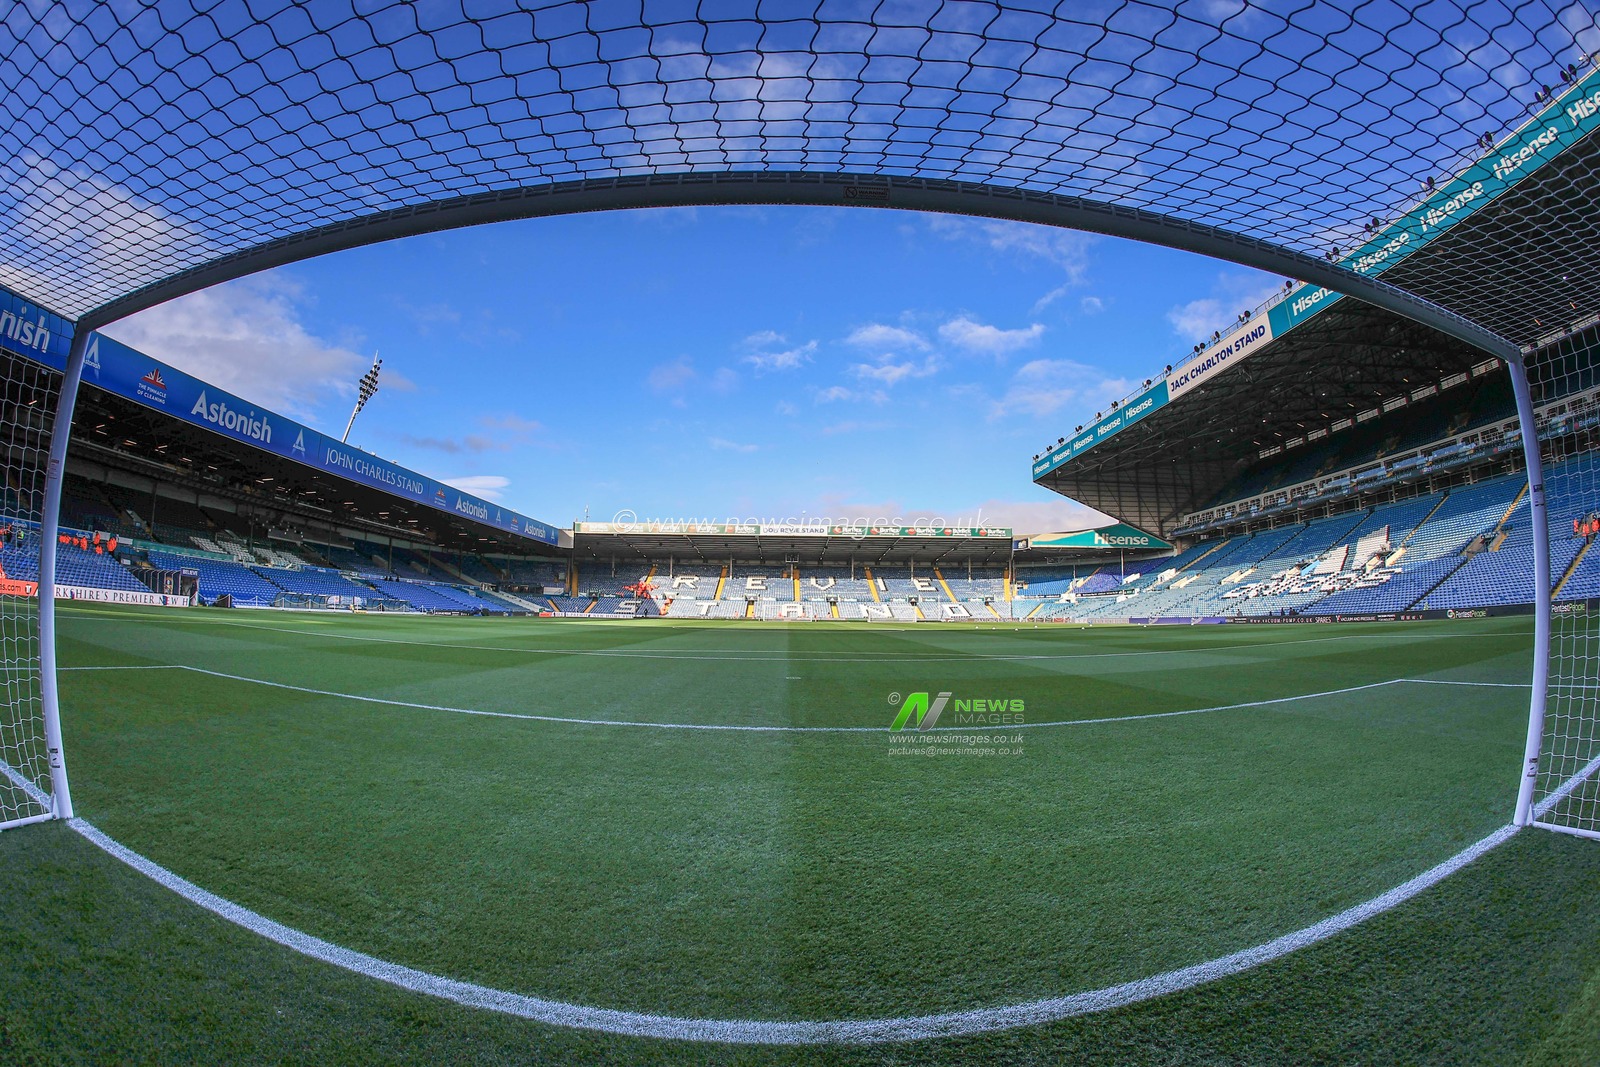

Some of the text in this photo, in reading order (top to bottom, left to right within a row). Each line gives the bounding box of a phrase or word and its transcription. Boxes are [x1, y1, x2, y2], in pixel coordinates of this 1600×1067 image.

[1492, 126, 1559, 180] Hisense
[1419, 182, 1484, 232] Hisense
[1352, 232, 1410, 273] Hisense
[1292, 287, 1334, 316] Hisen
[1171, 325, 1266, 392] JACK CHARLTON STAND
[191, 390, 272, 443] Astonish
[1126, 398, 1153, 420] Hisense
[1097, 417, 1121, 436] Hisense
[1073, 434, 1093, 451] Hisense
[1052, 448, 1071, 464] Hisense
[325, 448, 424, 494] JOHN CHARLES STAND
[1034, 461, 1050, 475] Hisense
[455, 496, 488, 520] Astonish
[524, 521, 546, 539] Astonish
[1094, 533, 1149, 545] Hisense
[113, 593, 155, 604] PREMIER
[1314, 616, 1332, 624] SPARES
